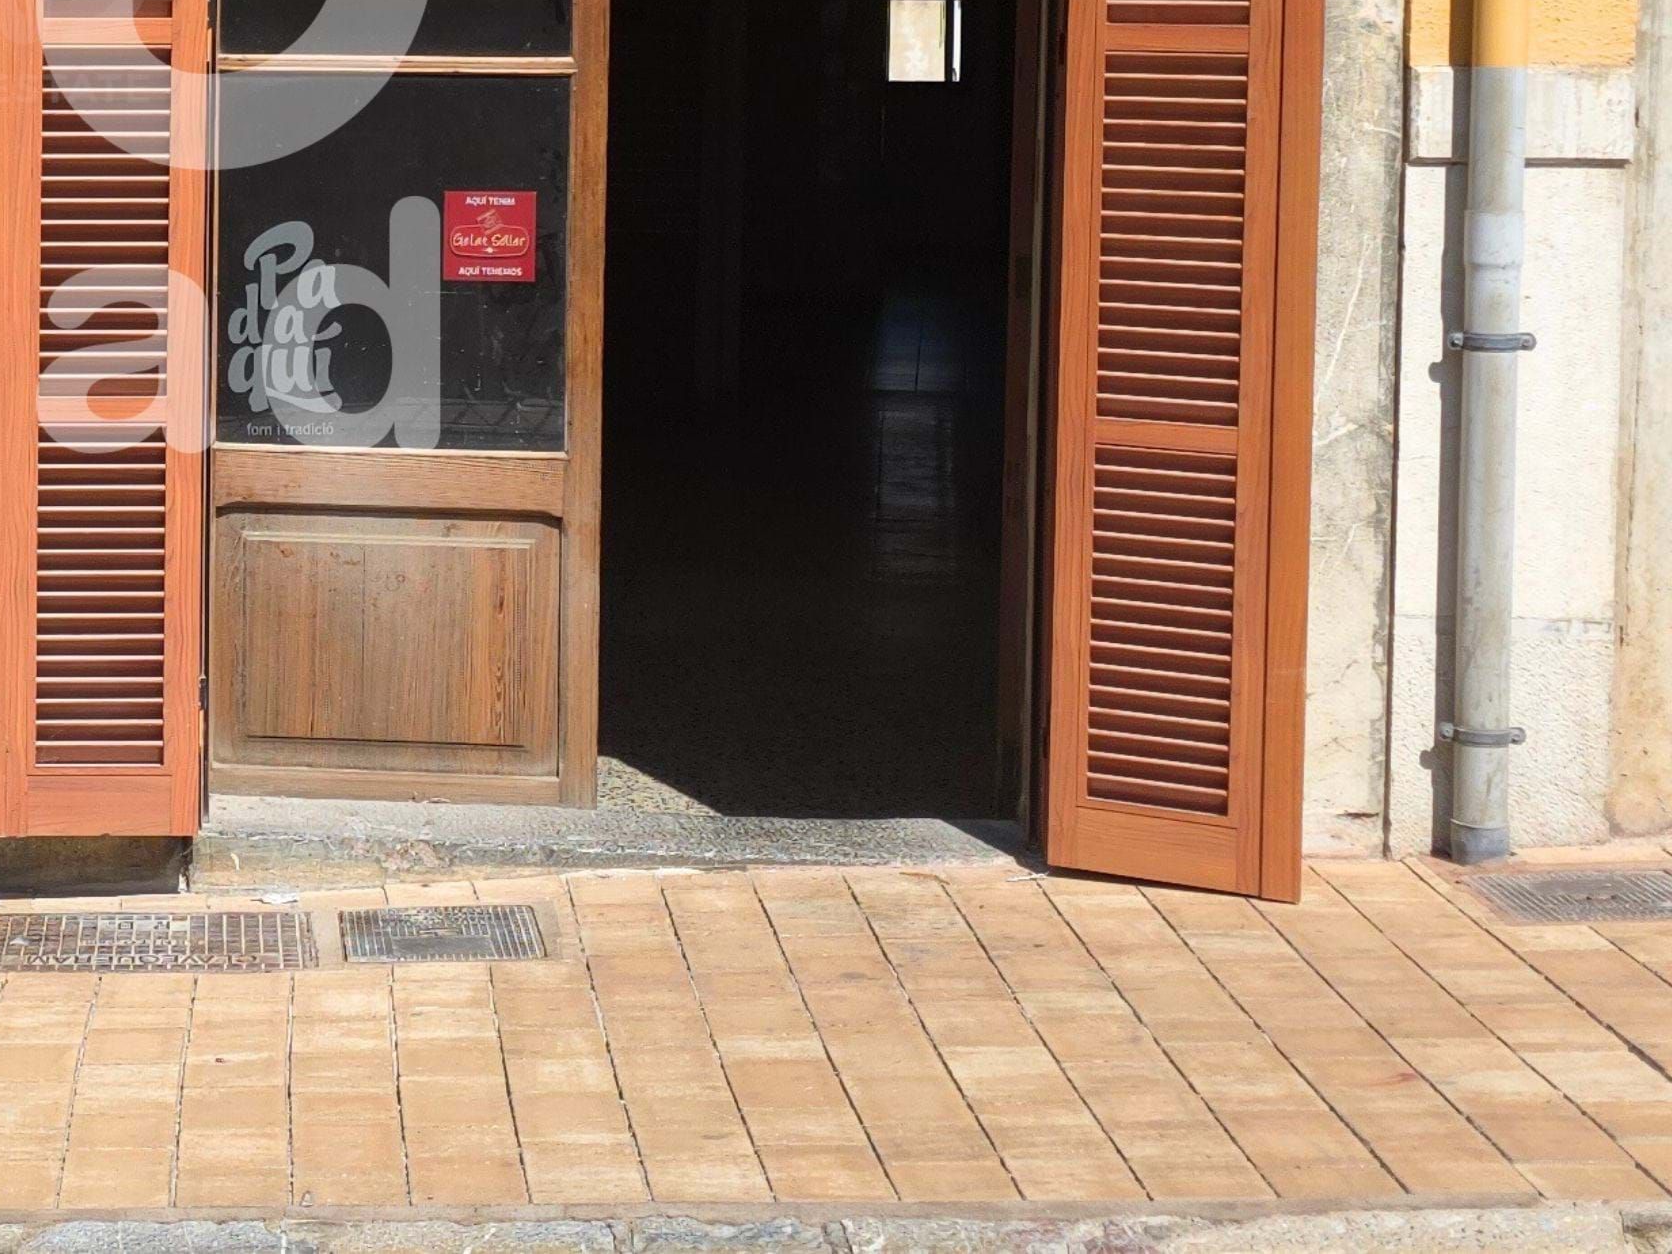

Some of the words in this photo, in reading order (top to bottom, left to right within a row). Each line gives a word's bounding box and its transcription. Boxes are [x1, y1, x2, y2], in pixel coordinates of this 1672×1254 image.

[244, 221, 342, 310] Pa
[246, 422, 273, 436] forn
[285, 422, 335, 436] tradició
